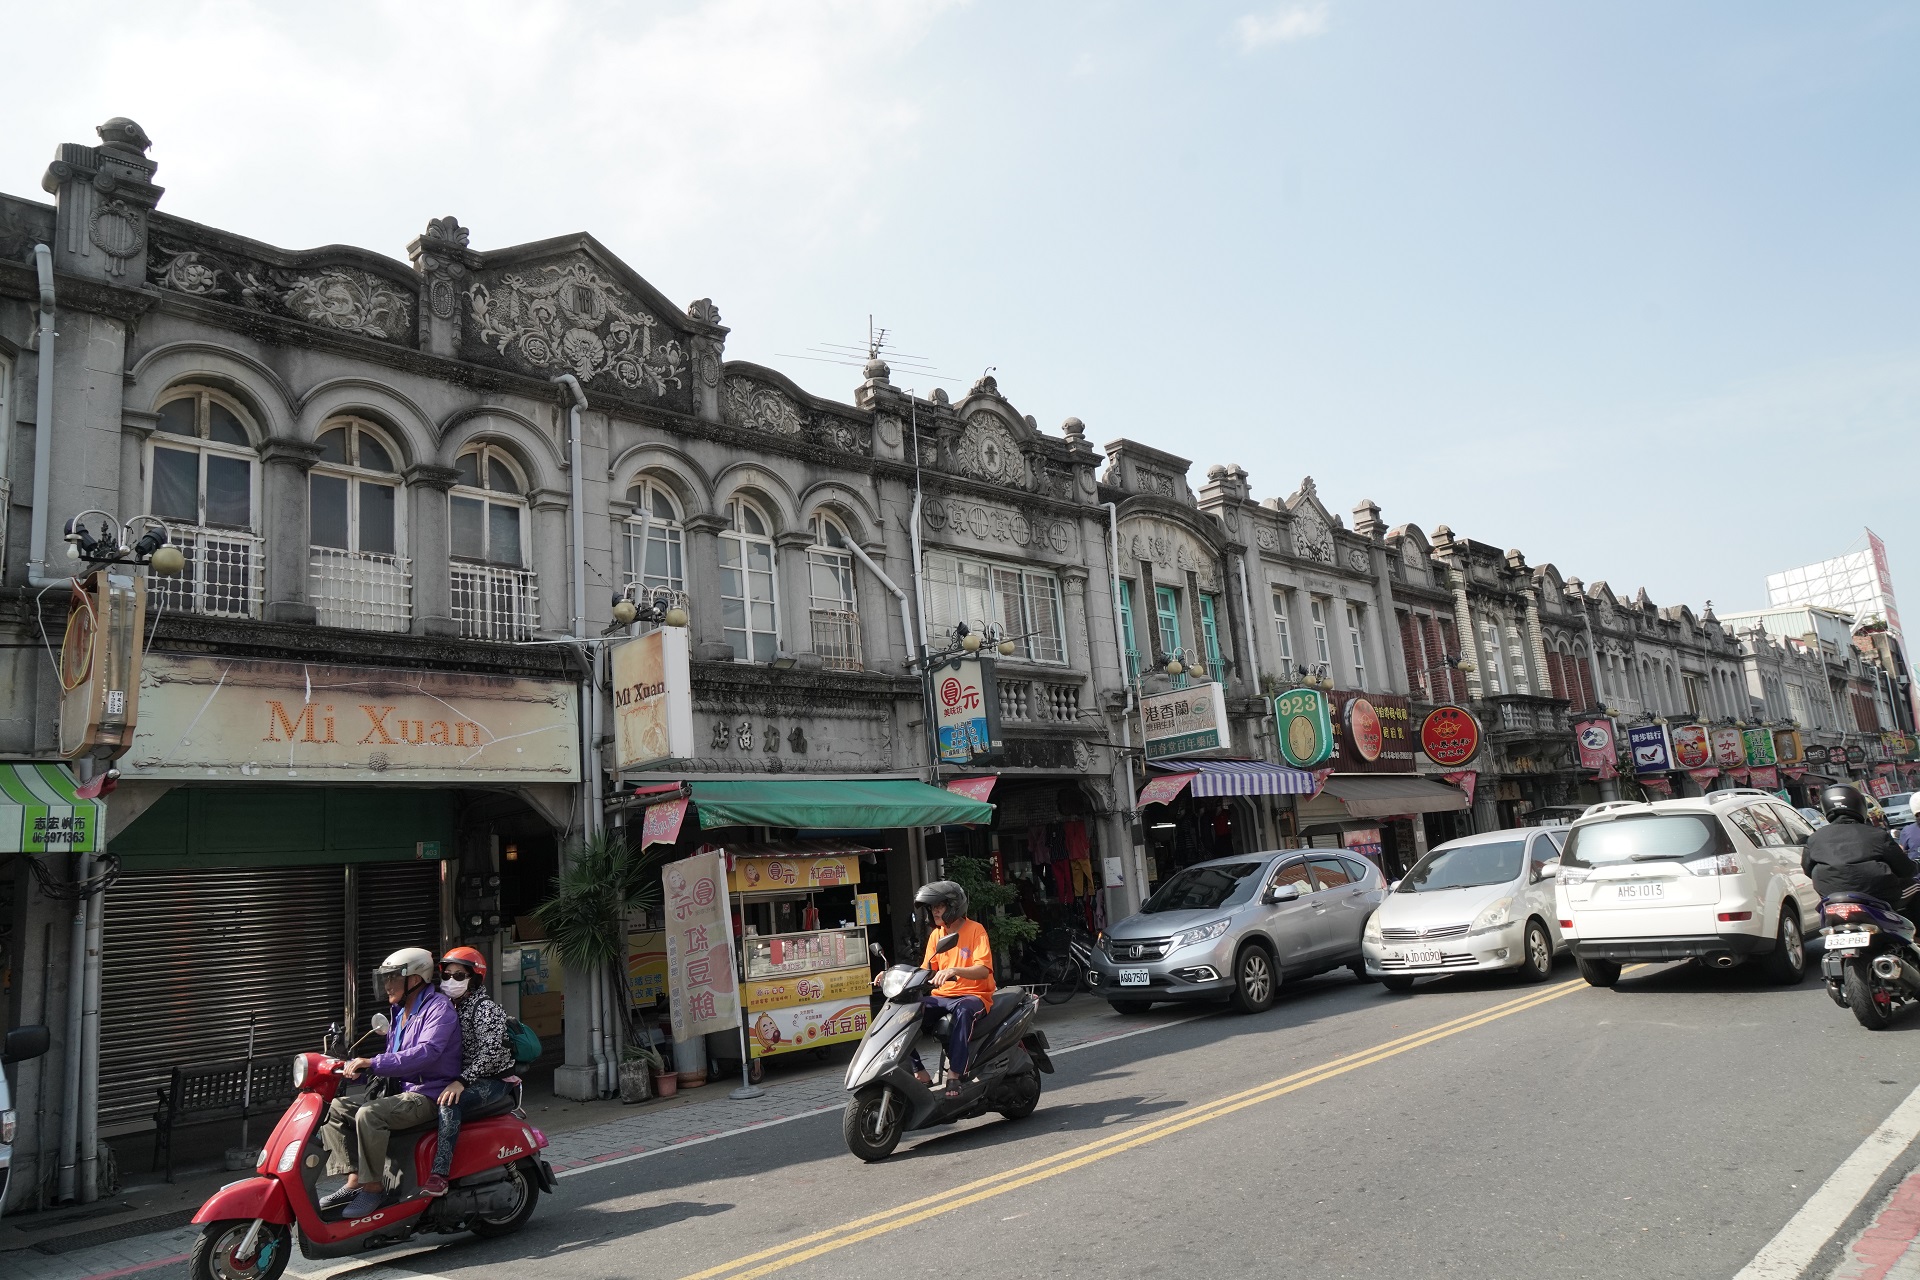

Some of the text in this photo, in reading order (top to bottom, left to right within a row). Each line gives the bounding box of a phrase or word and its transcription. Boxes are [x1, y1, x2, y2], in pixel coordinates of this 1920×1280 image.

[634, 682, 666, 702] Xuan
[1145, 700, 1189, 723] 港香蘭
[1280, 694, 1316, 716] 923
[262, 700, 483, 747] Mi Xuan
[1719, 740, 1738, 762] 咖啡
[34, 817, 86, 830] 志宏帆布
[32, 832, 85, 843] 06-5971363
[810, 865, 846, 880] 紅豆餅
[631, 985, 663, 999] 改黃豆
[823, 1013, 868, 1037] 紅豆餅
[350, 1212, 385, 1228] PGO
